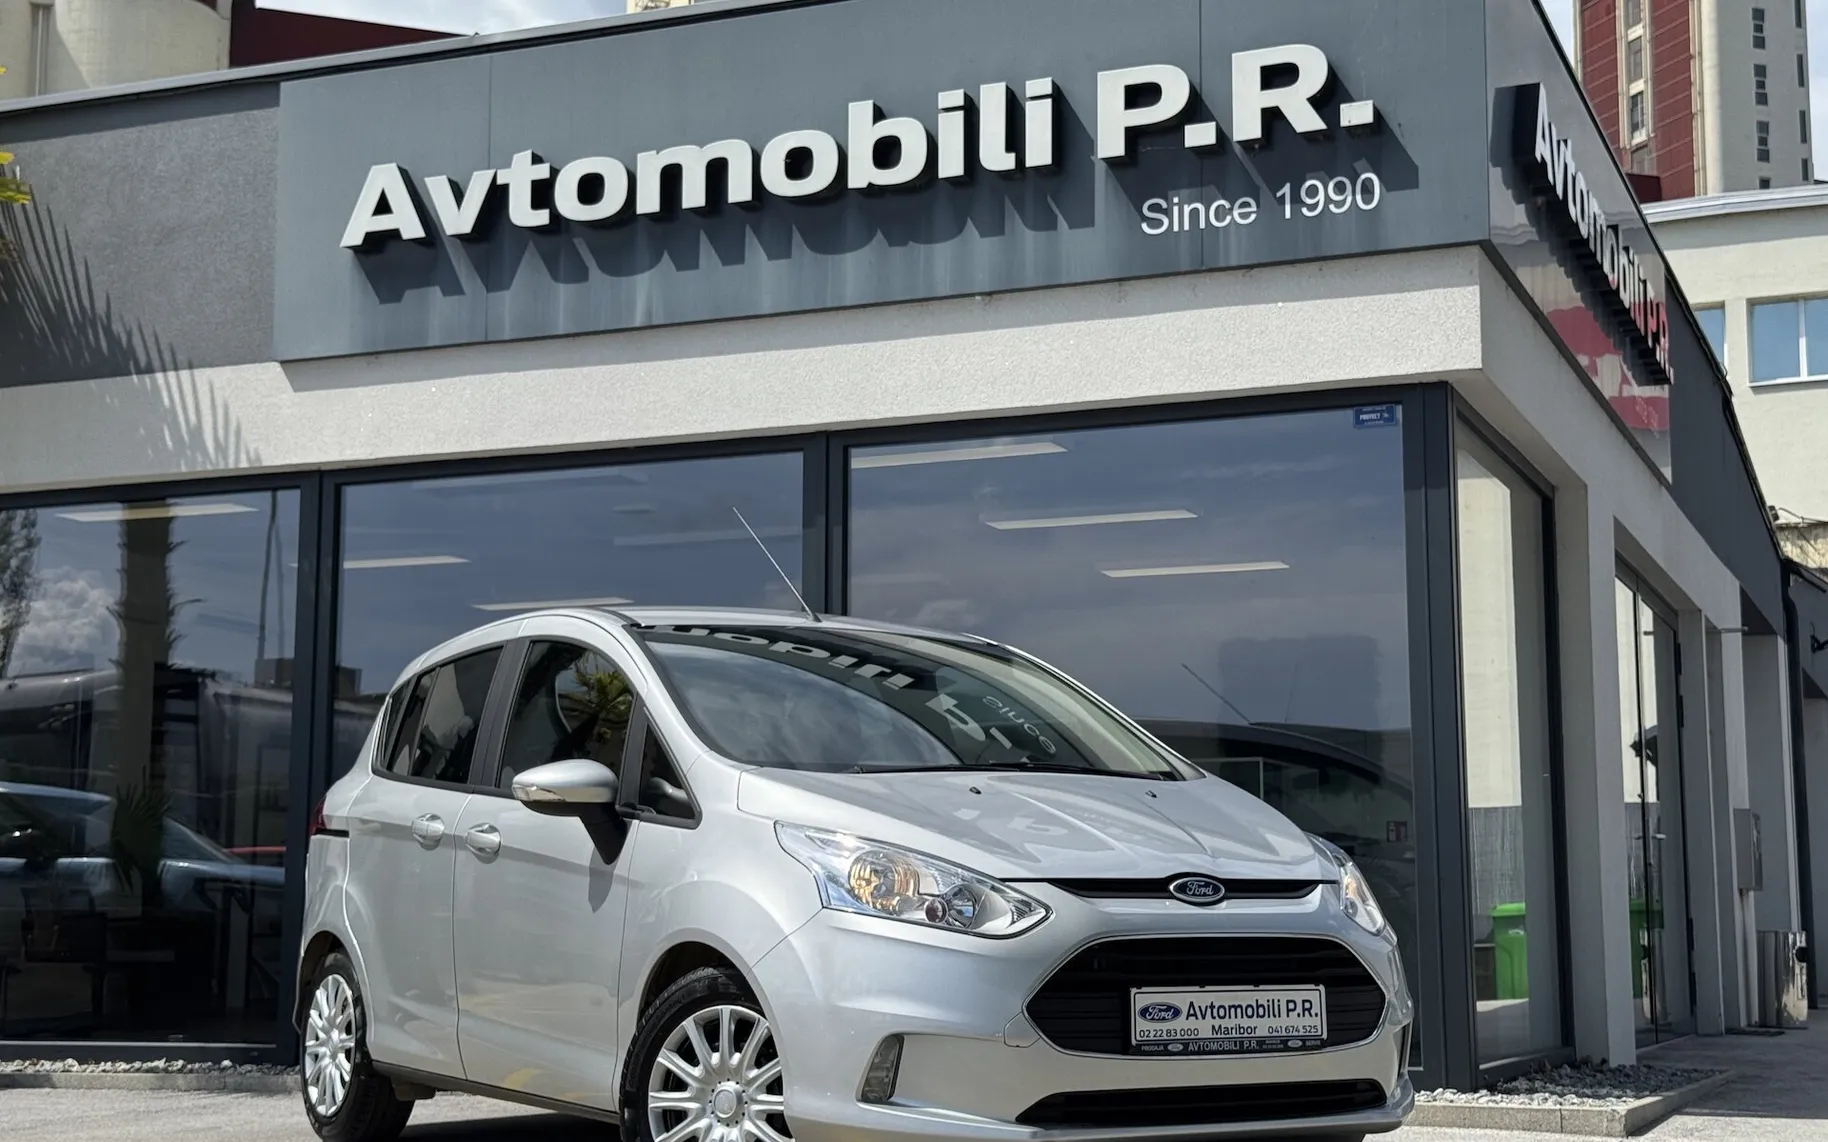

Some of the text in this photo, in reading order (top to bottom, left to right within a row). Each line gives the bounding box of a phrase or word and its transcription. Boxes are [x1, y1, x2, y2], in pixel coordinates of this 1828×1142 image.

[340, 43, 1378, 249] Avtomobili P.R.
[1140, 172, 1380, 235] Since 1990
[1535, 82, 1645, 337] Avtomobili
[1186, 881, 1213, 895] Ford
[1185, 998, 1319, 1021] Avtomobili P.R.
[1139, 1029, 1151, 1039] 02
[1165, 1028, 1178, 1038] 83
[1179, 1027, 1200, 1037] 000
[1211, 1023, 1258, 1036] Maribor
[1267, 1024, 1319, 1035] 041 674 525
[1188, 1040, 1240, 1052] AVTOMOBILI
